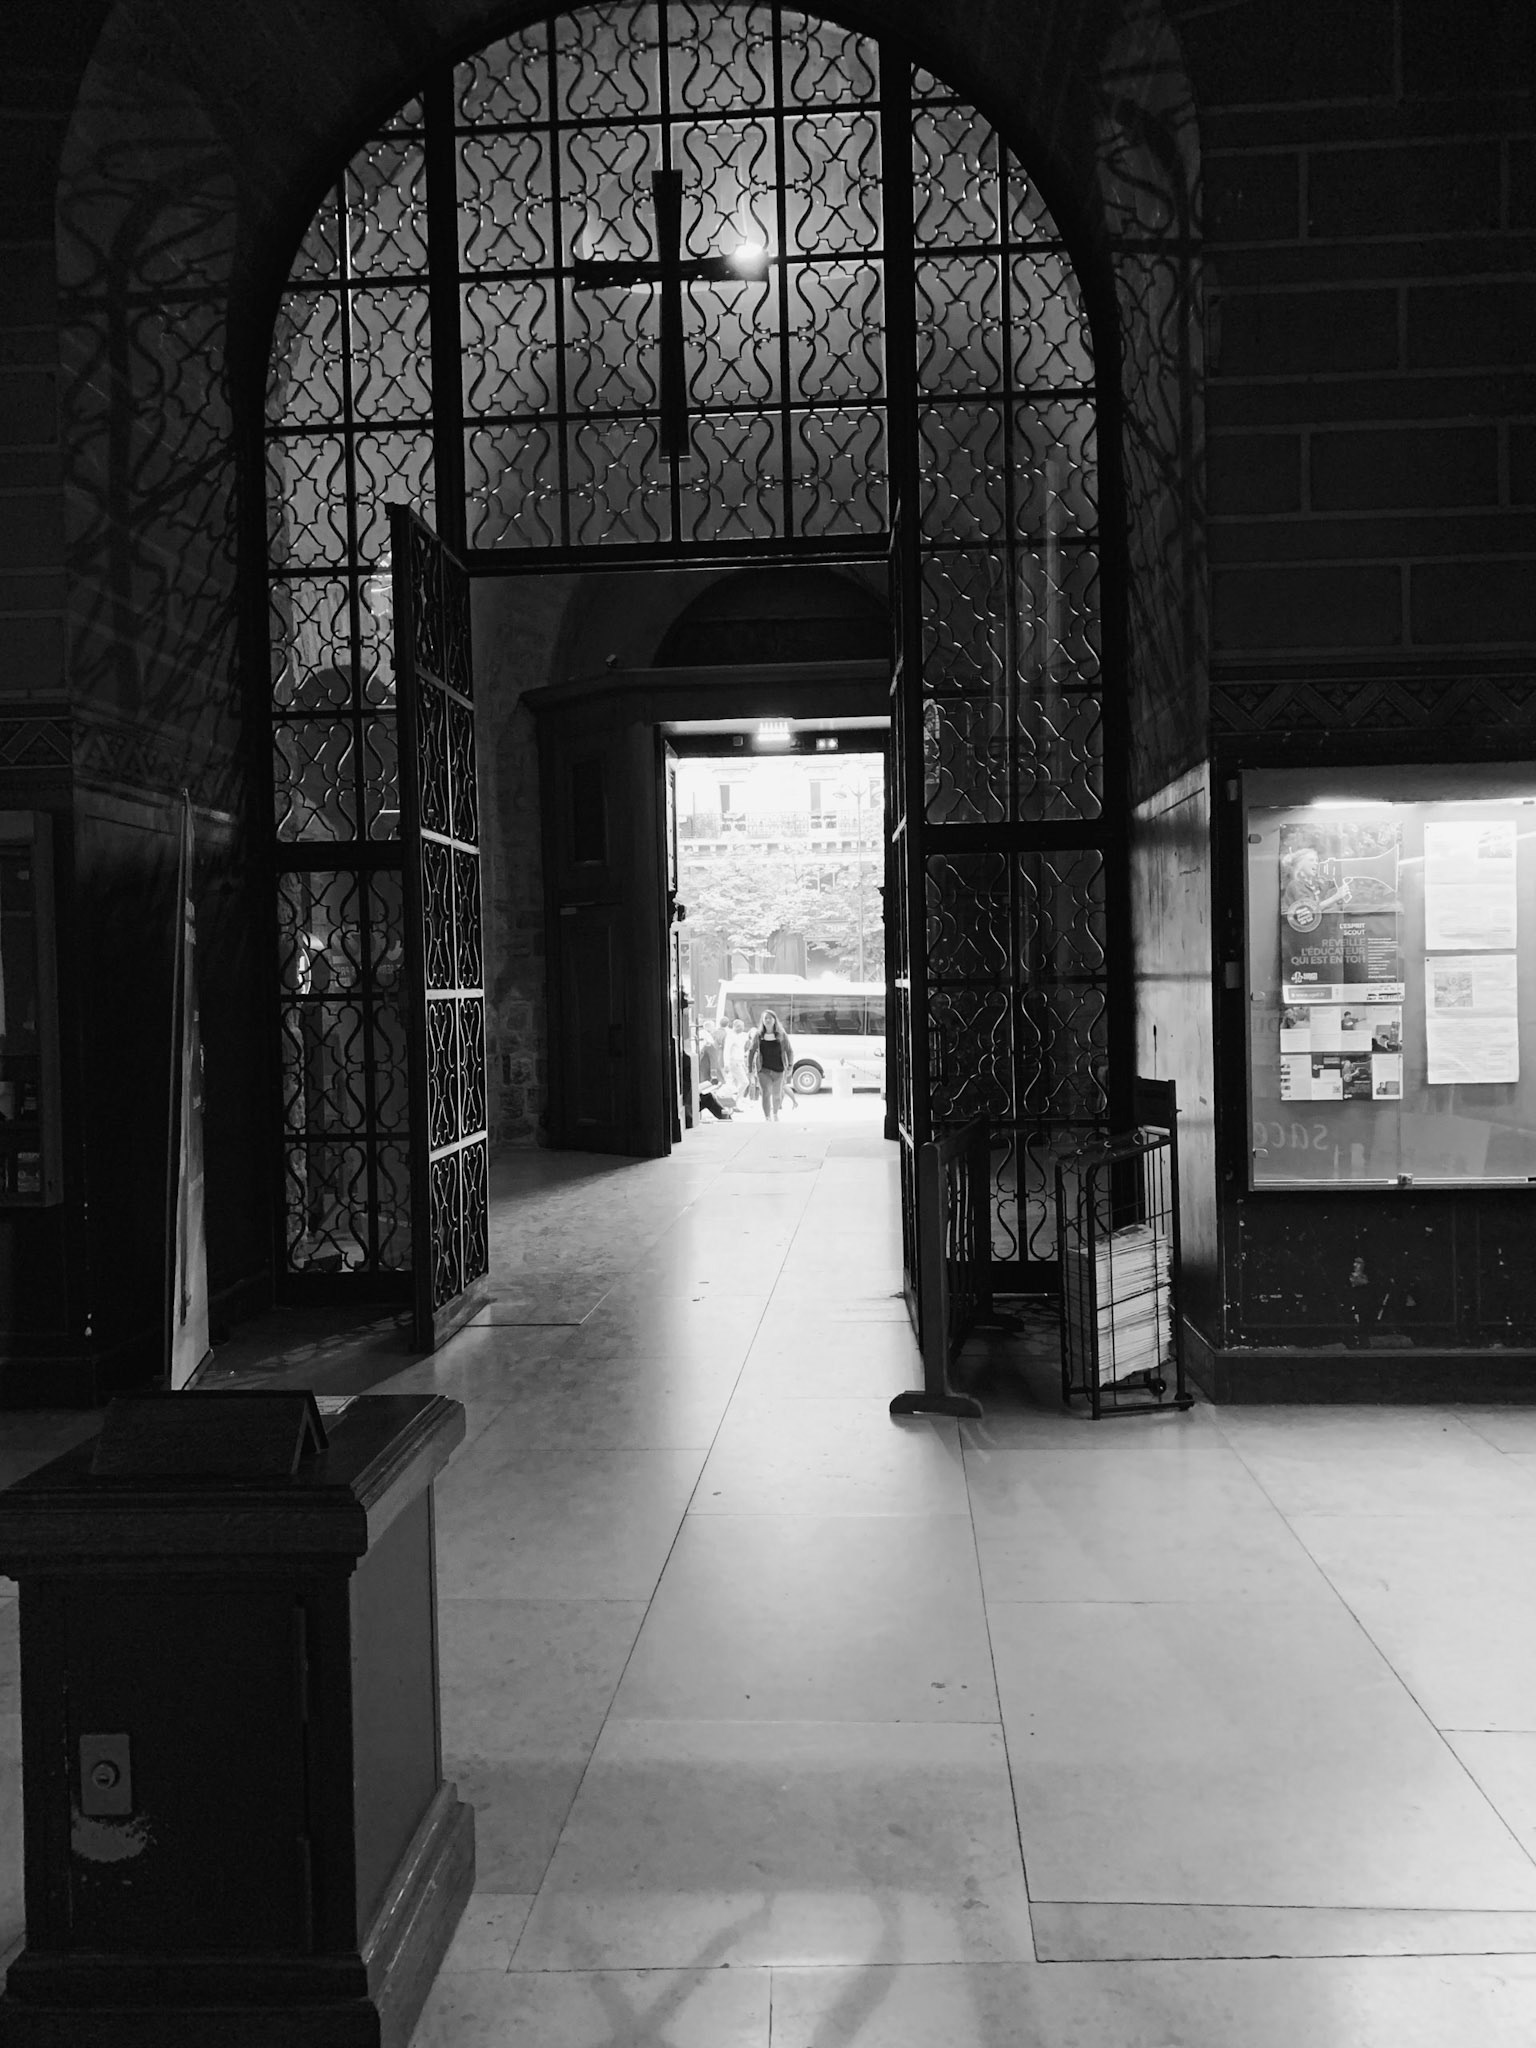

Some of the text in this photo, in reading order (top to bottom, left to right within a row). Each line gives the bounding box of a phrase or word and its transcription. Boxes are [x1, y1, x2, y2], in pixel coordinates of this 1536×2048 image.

[1321, 937, 1366, 947] RÉVEILLE
[1302, 946, 1366, 956] L'ÉDUCATEUR
[1291, 956, 1309, 966] QUI
[1310, 956, 1328, 965] EST
[1330, 955, 1343, 965] EN
